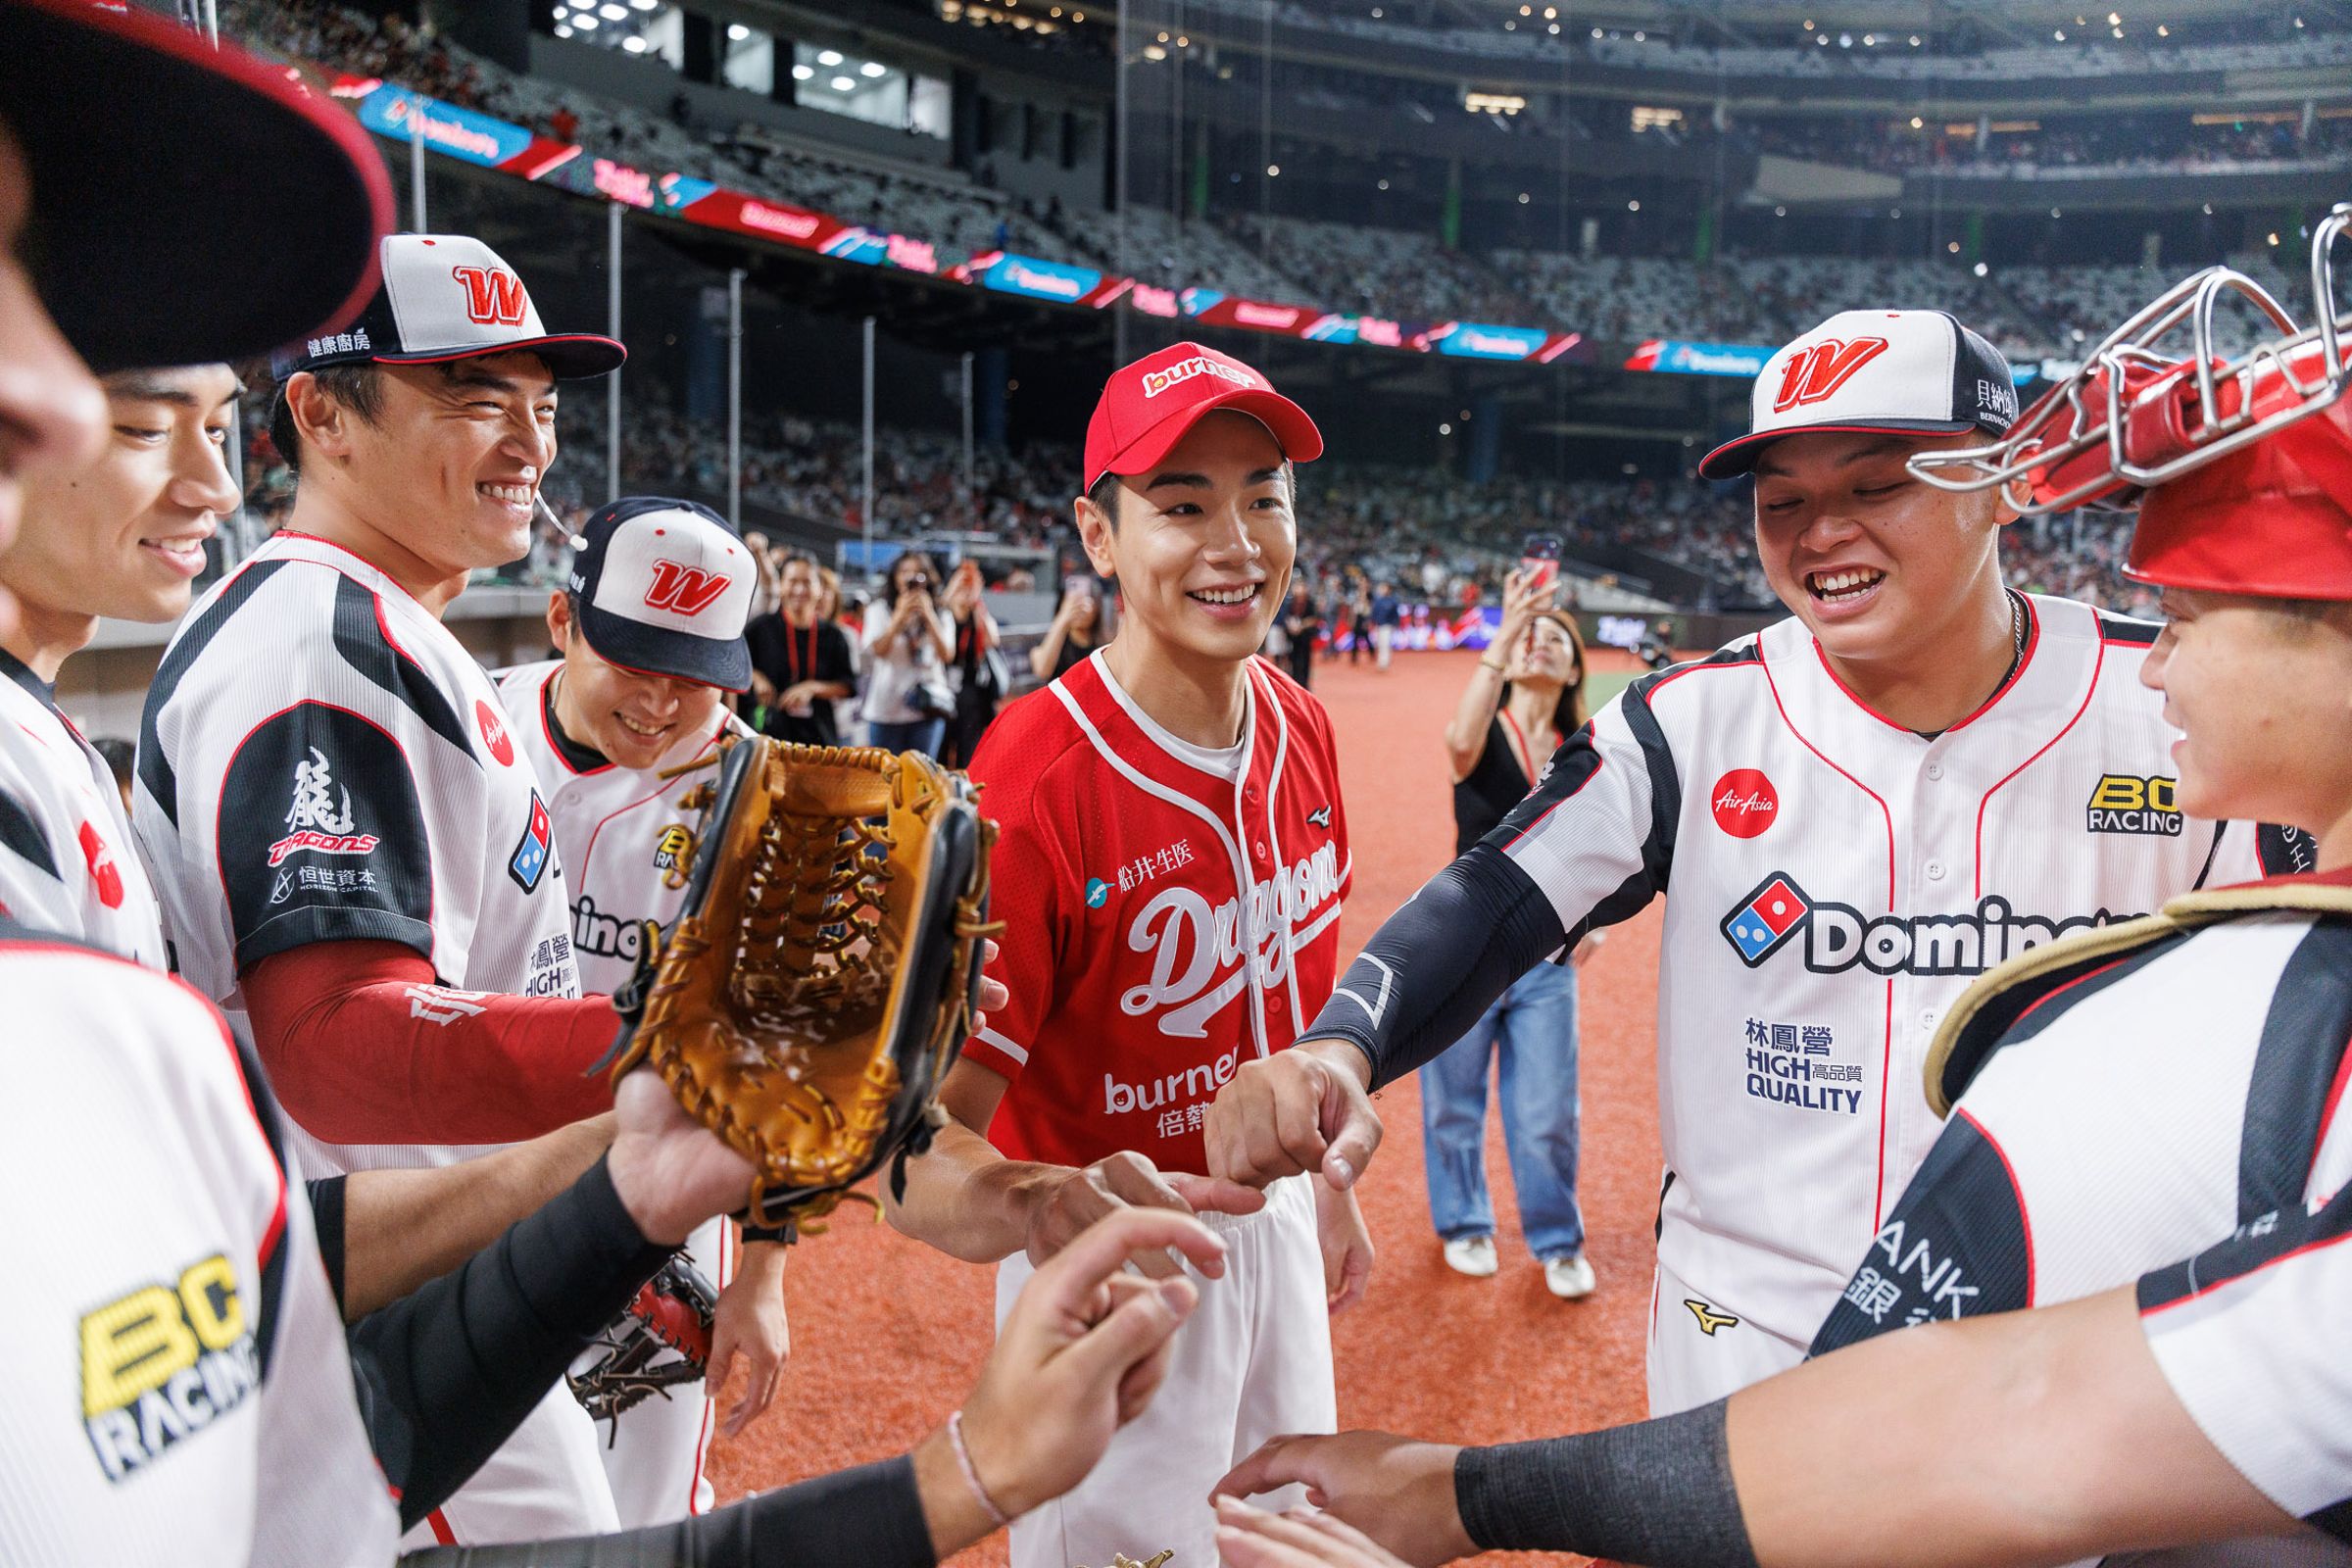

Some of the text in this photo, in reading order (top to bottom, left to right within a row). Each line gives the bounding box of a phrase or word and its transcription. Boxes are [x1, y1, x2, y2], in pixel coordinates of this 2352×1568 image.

[307, 327, 370, 359] 健康廚房
[1142, 356, 1255, 399] burner
[1774, 336, 1889, 415] W
[644, 559, 732, 616] W
[1715, 788, 1774, 815] AirAsia
[2087, 809, 2182, 835] RACING
[1745, 1017, 1833, 1056] 林鳳營
[1745, 1048, 1863, 1083] HIGH 高品質
[1746, 1073, 1863, 1114] QUALITY
[79, 1254, 245, 1419] BC
